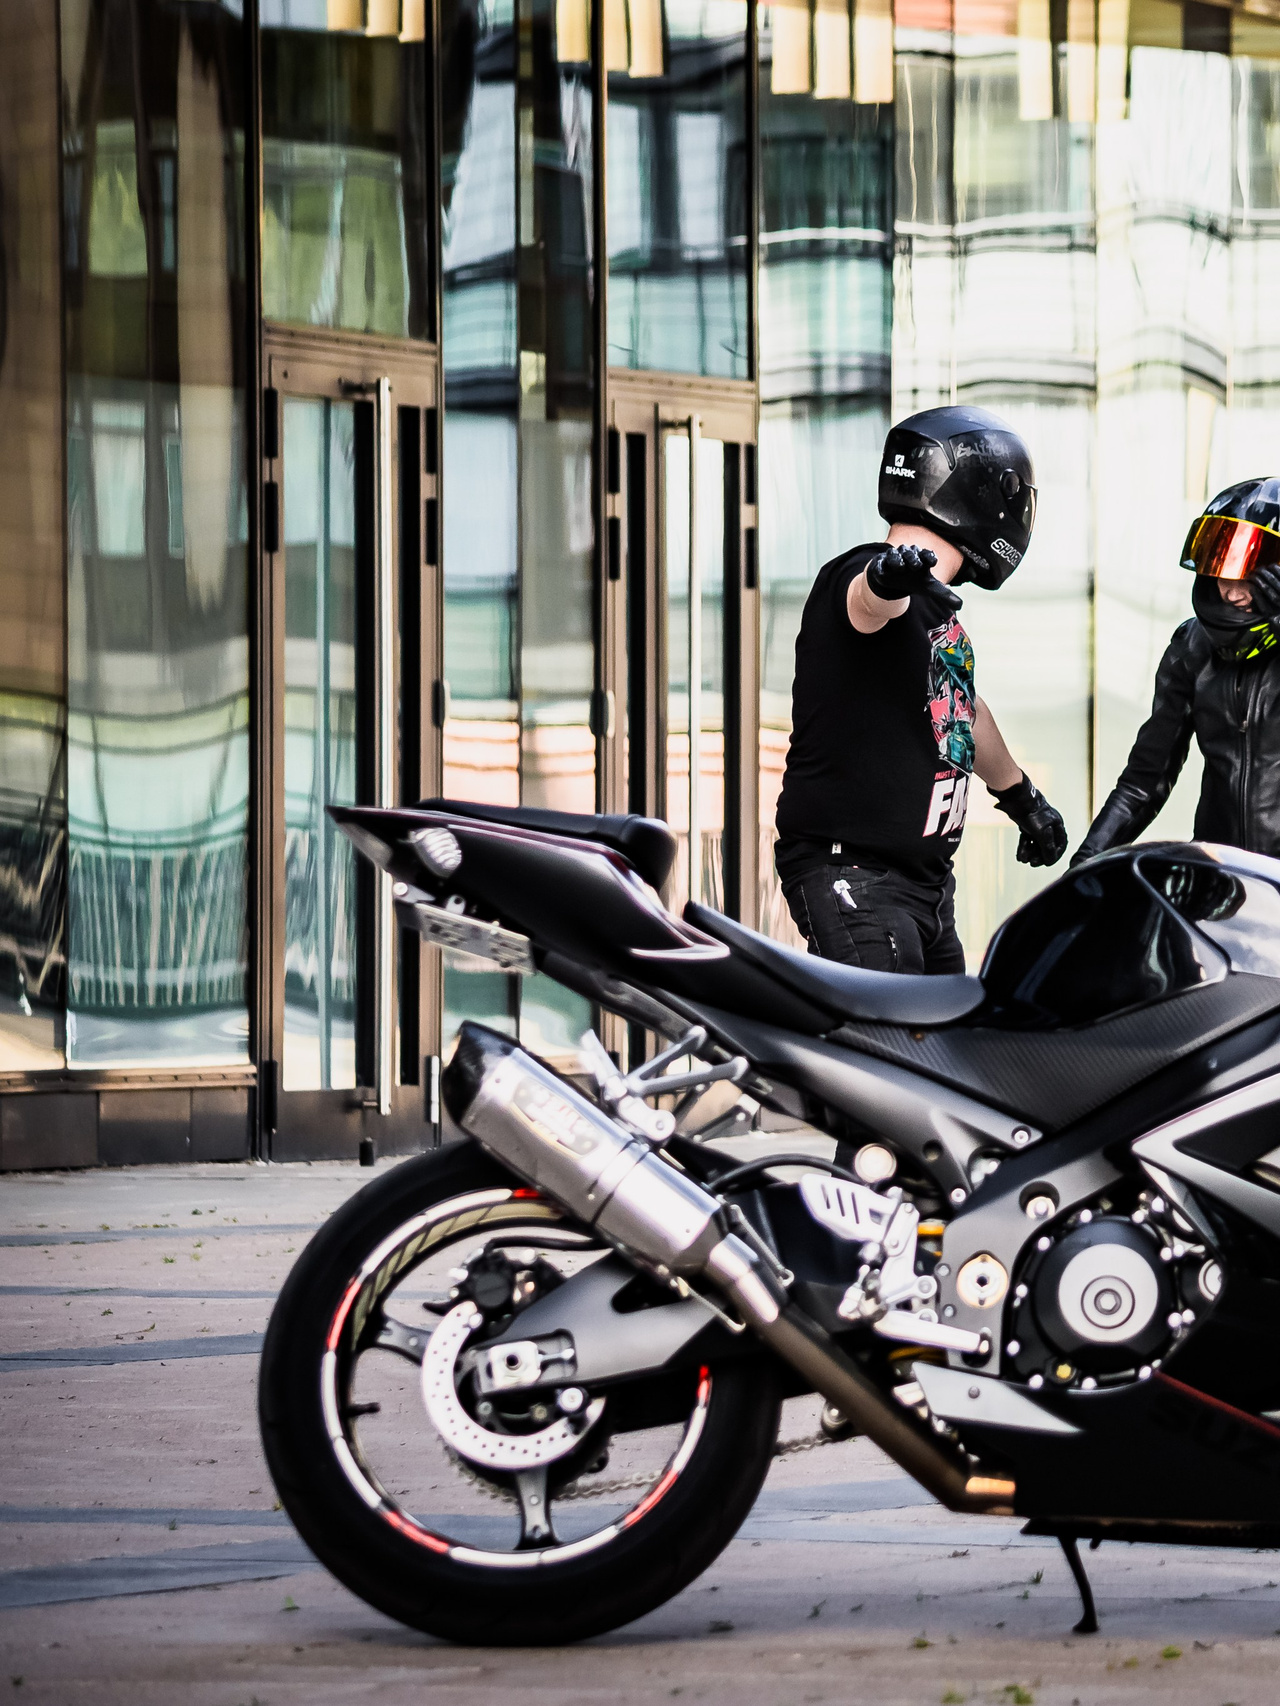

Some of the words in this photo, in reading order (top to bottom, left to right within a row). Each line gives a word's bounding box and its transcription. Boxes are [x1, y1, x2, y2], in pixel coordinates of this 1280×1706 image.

[885, 465, 916, 479] SHARK
[991, 538, 1022, 567] SHAR
[922, 775, 971, 837] FA
